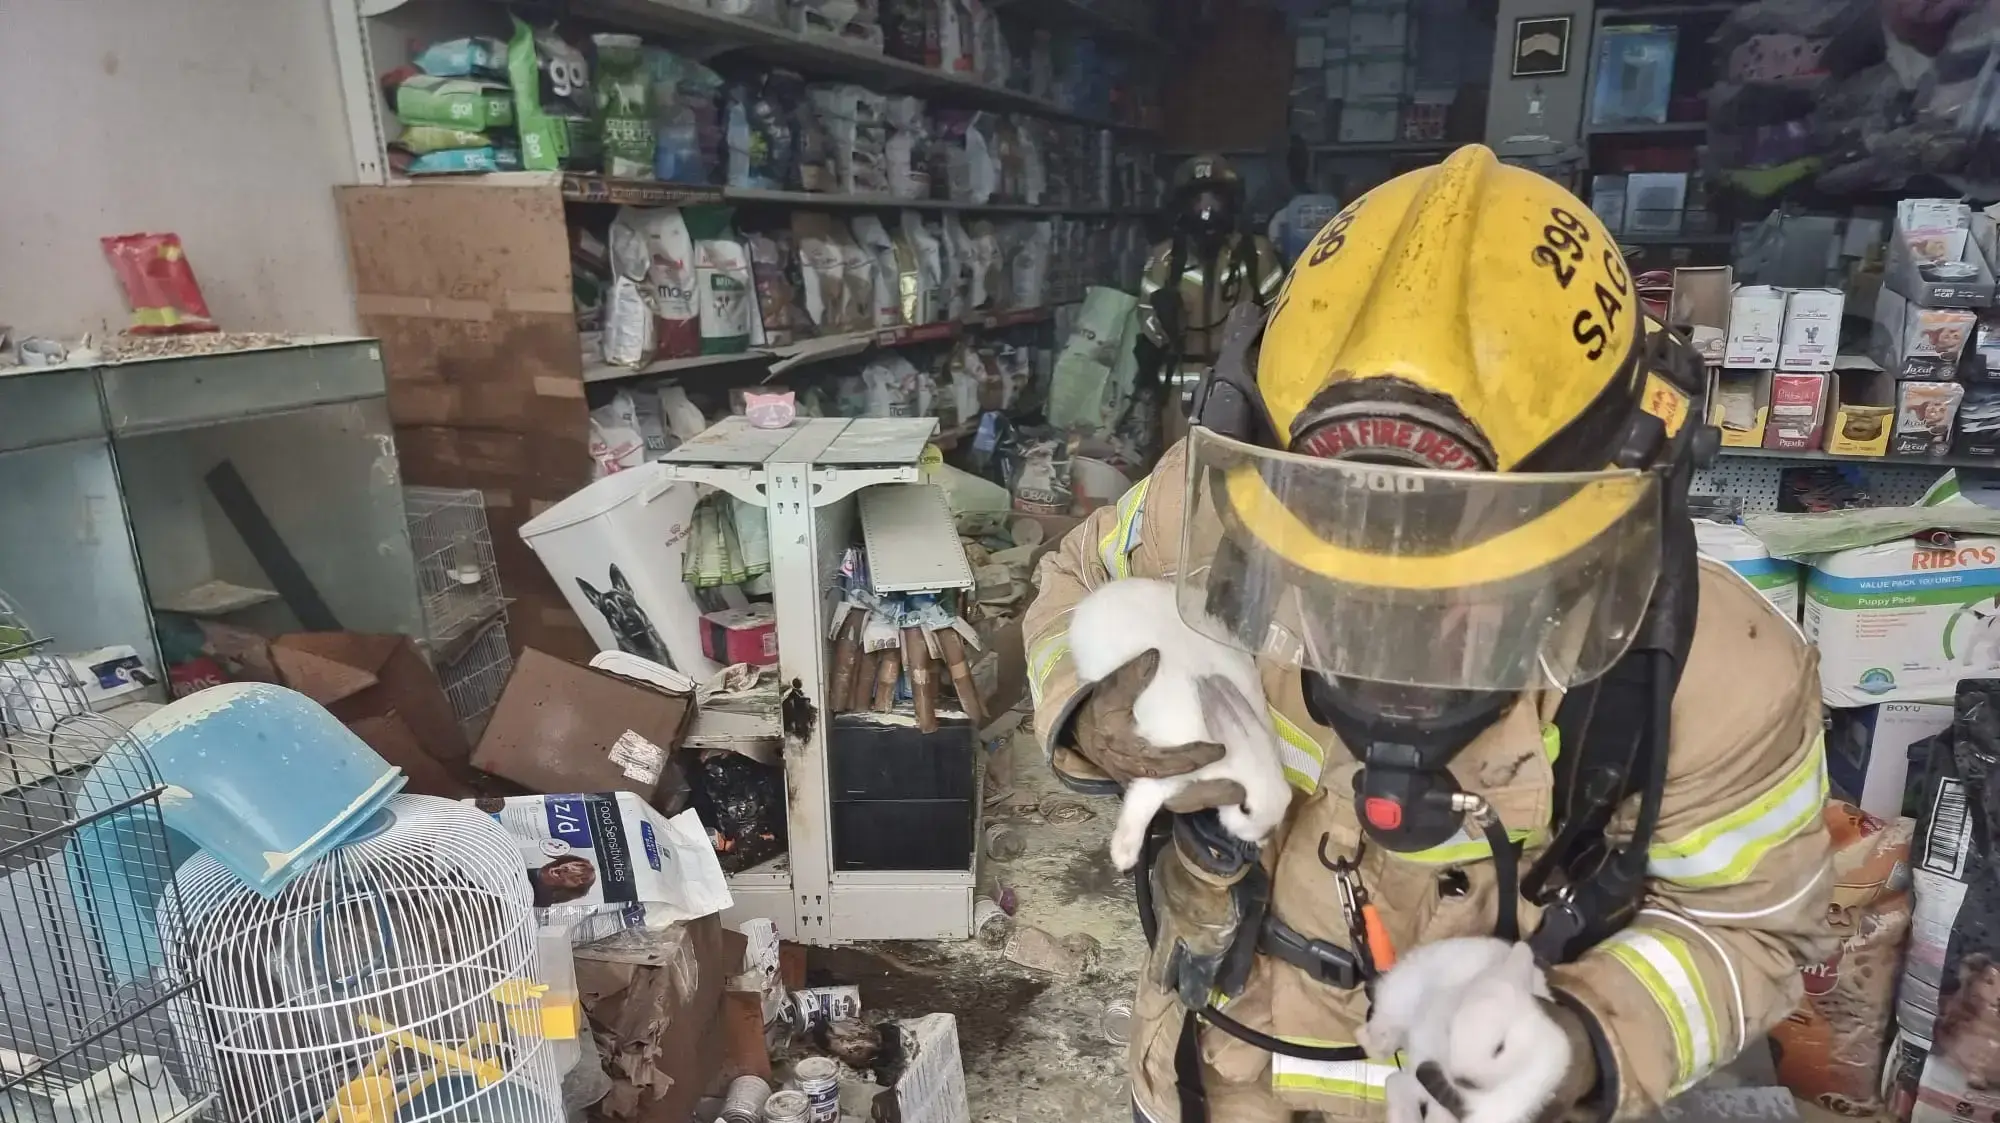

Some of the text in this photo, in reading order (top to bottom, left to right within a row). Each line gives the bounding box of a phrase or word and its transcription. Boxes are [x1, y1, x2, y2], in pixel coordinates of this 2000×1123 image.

[1534, 207, 1590, 290] 299
[1572, 249, 1628, 361] SAG
[1356, 417, 1415, 449] FIRE
[1413, 431, 1478, 471] DEPT
[1911, 546, 1997, 571] RIBOS
[1860, 581, 1890, 589] VALUE
[1891, 578, 1916, 588] PACK
[1858, 597, 1890, 606] Puppy
[1886, 704, 1921, 713] BOYU
[554, 803, 581, 833] z/d
[600, 800, 616, 825] Food
[605, 825, 625, 882] Sensitivities
